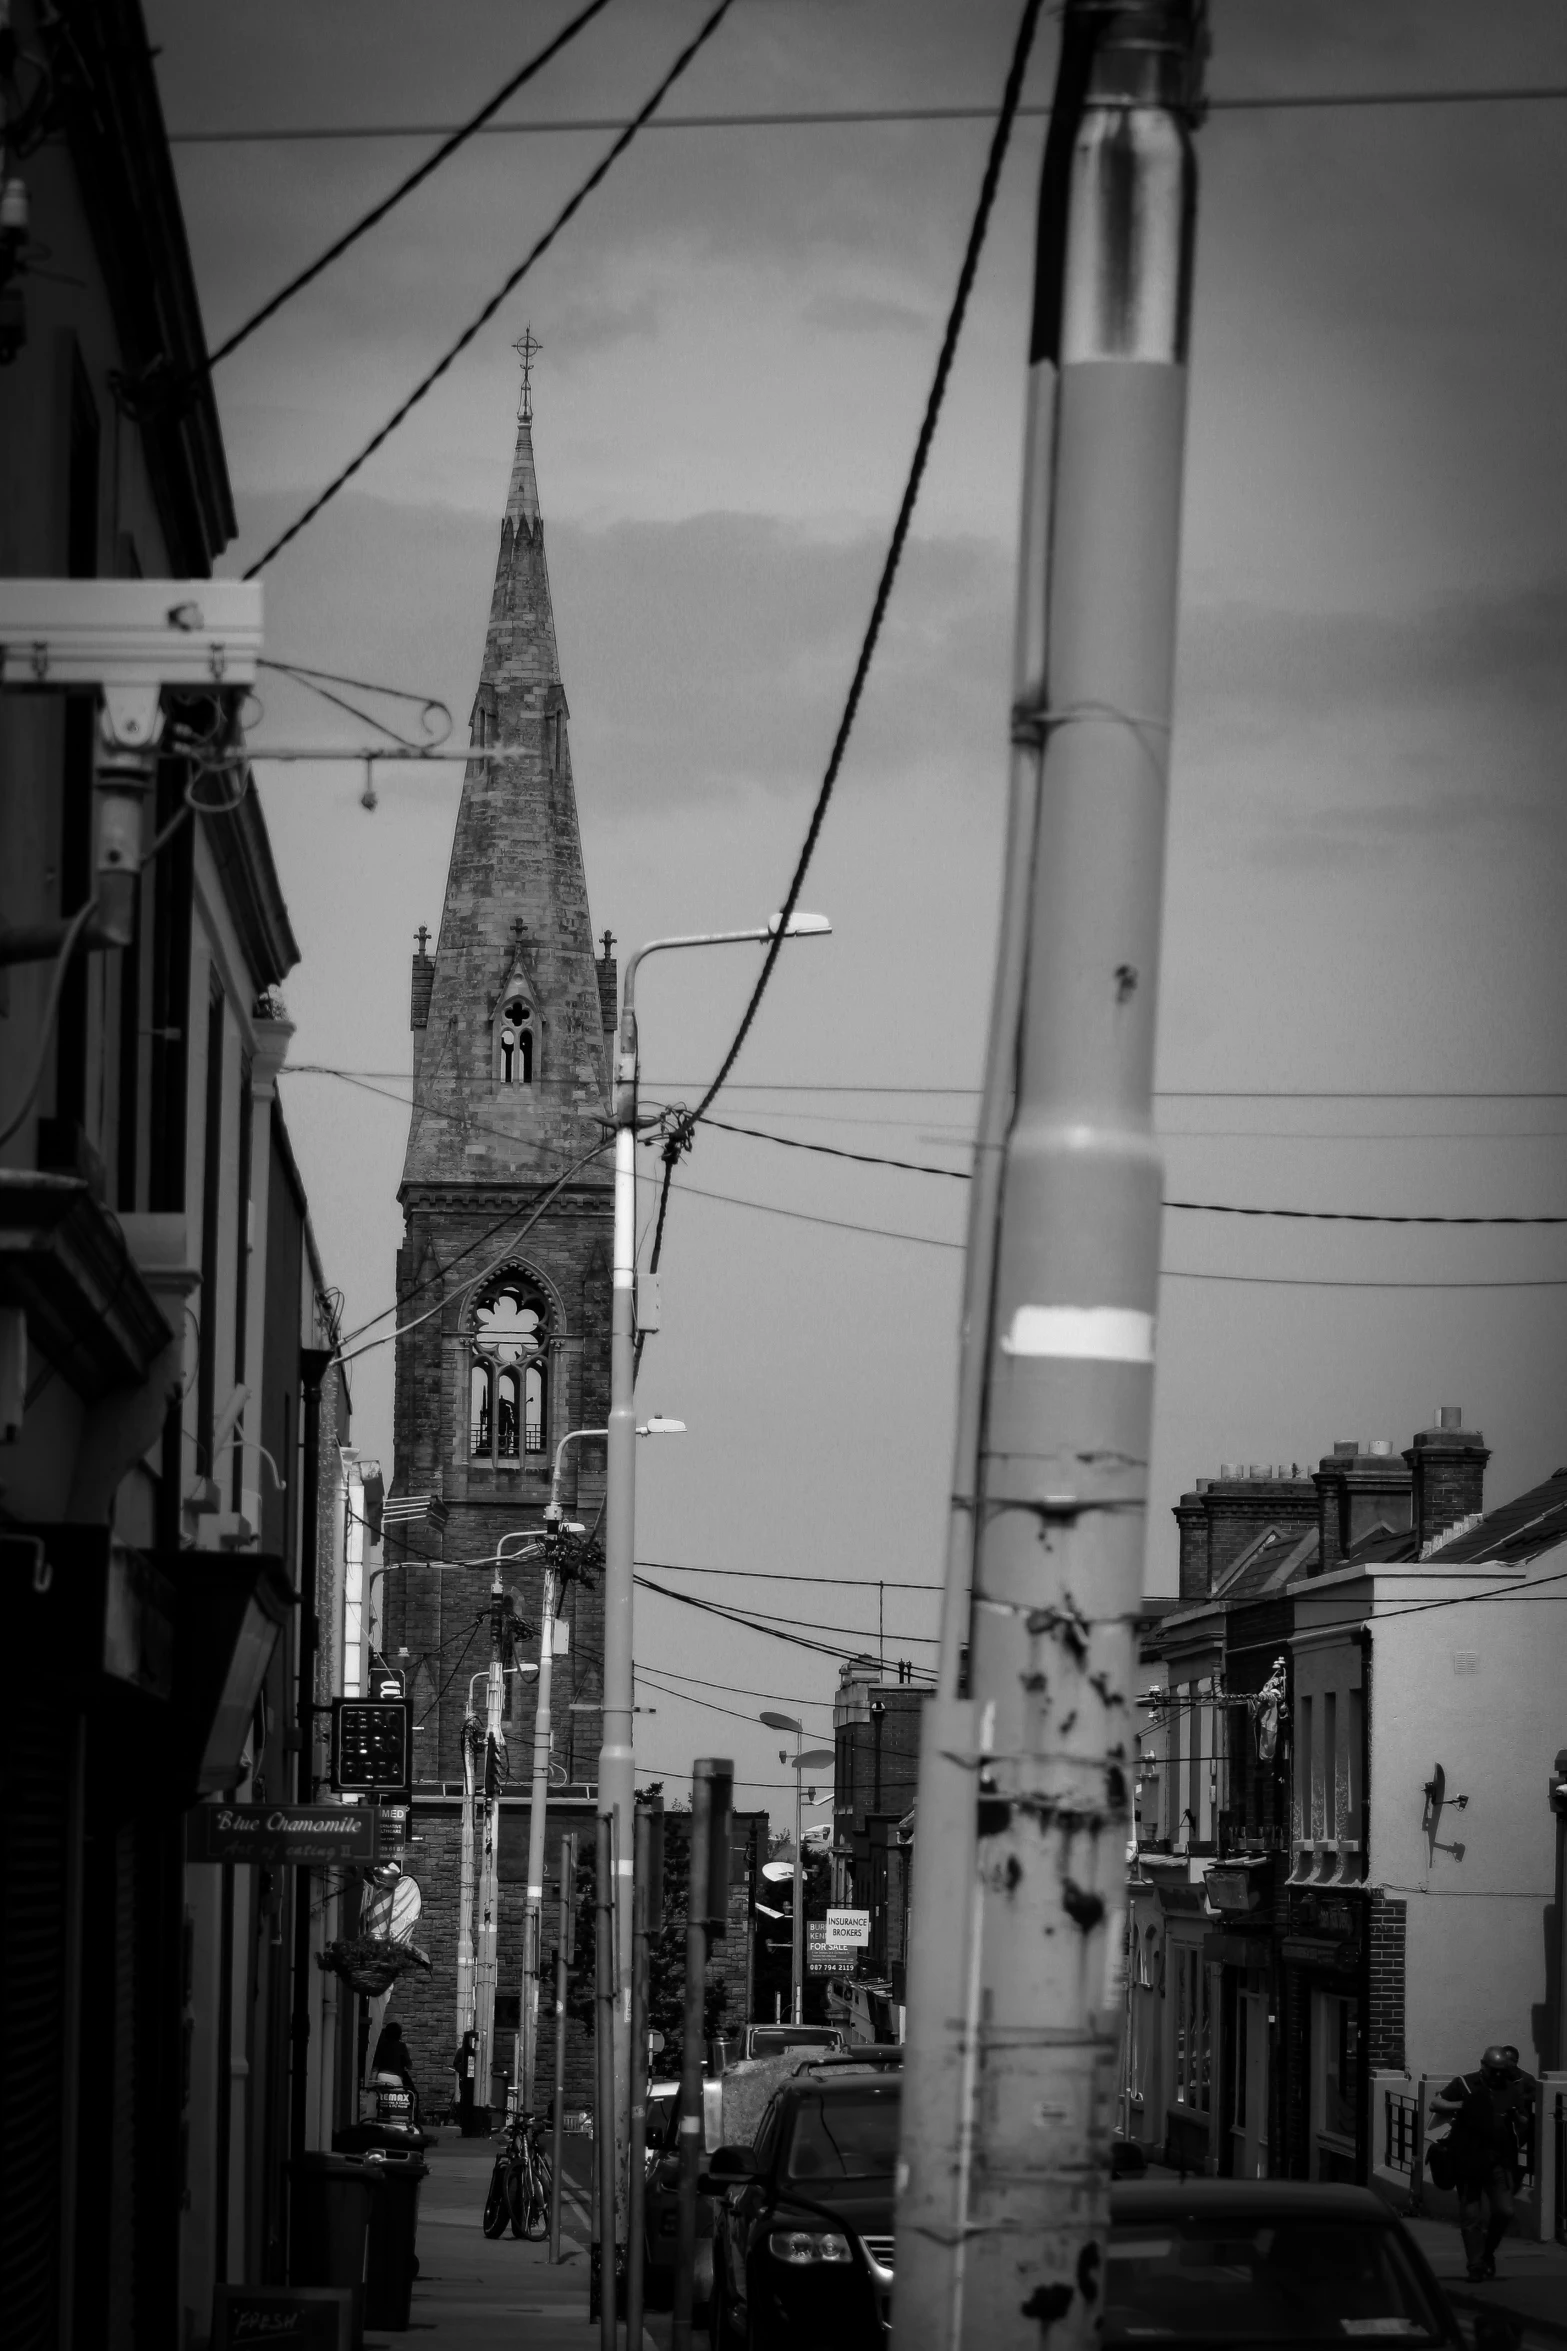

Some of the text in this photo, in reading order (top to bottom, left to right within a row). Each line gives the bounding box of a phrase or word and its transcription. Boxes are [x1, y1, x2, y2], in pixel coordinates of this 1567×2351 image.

[345, 1710, 401, 1729] ZERO
[345, 1735, 401, 1753] ZERO
[345, 1761, 403, 1779] PIZZA
[217, 1810, 362, 1833] Blue Chamomile
[828, 1917, 867, 1926] INSURANCE
[810, 1923, 827, 1931] BUR
[810, 1932, 826, 1940] KEN
[832, 1928, 862, 1937] BROKERS
[810, 1942, 826, 1950] FOR
